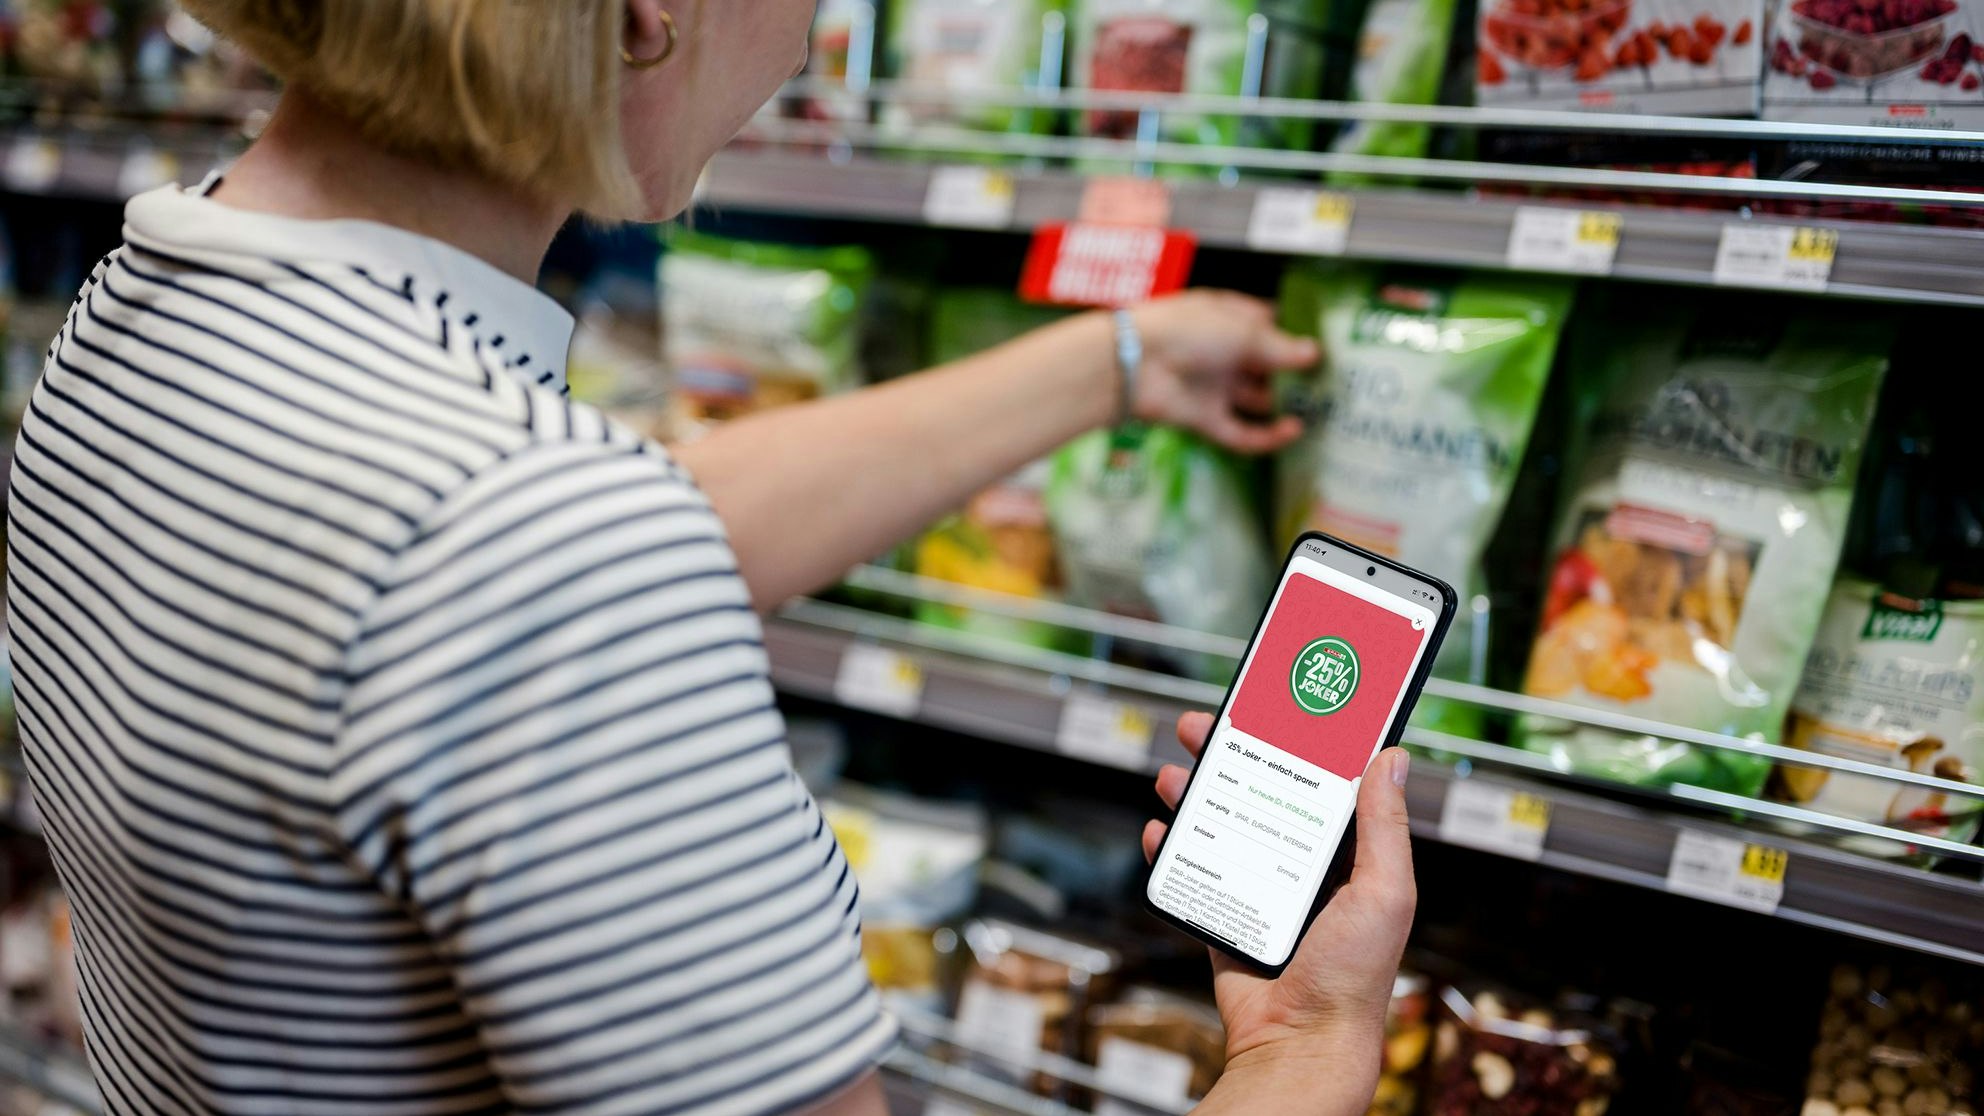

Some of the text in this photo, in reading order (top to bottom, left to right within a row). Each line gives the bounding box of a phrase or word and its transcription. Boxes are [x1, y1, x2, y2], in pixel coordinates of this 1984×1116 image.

[1304, 543, 1321, 555] 11:40
[1304, 652, 1352, 693] -25%
[1298, 677, 1340, 705] JOKER
[1217, 771, 1238, 784] Zeitraum
[1225, 741, 1240, 753] -25%
[1242, 749, 1261, 761] Joker
[1267, 761, 1292, 776] einfach
[1293, 773, 1319, 789] sparen!
[1247, 785, 1258, 793] Nur
[1257, 790, 1274, 801] heute
[1307, 814, 1324, 826] gültig
[1234, 811, 1312, 852] SPAR, EUROSPAR, INTERSPAR
[1276, 865, 1299, 881] Einmalig
